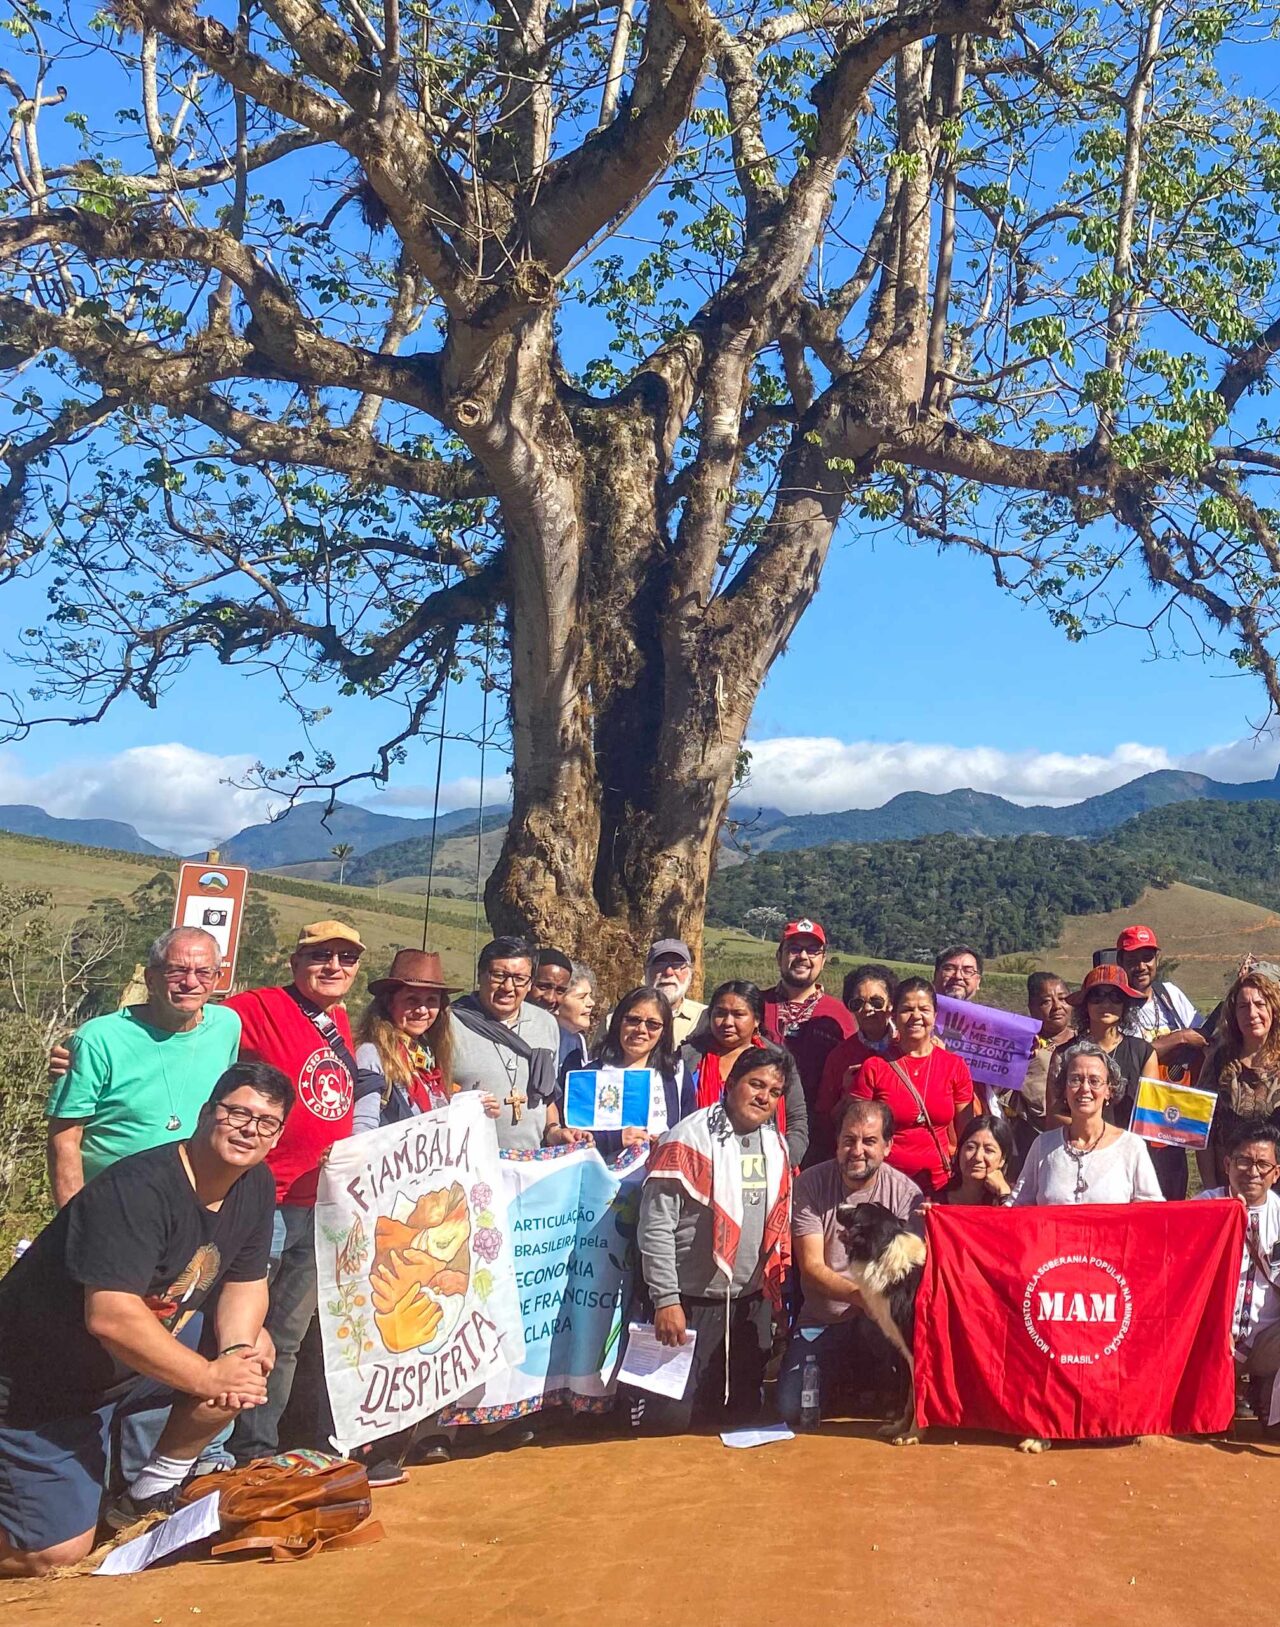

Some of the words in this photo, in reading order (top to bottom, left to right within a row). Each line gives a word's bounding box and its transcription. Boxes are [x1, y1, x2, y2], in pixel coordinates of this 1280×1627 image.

[972, 1021, 986, 1031] LA
[944, 1038, 960, 1049] NO
[961, 1041, 977, 1052] ES
[978, 1046, 1011, 1061] ZONA
[970, 1031, 1015, 1050] MESETA
[306, 1053, 321, 1073] OSO
[964, 1057, 1009, 1075] CRIFICIO
[514, 1207, 595, 1232] ARTICULAÇÃO
[514, 1234, 577, 1257] BRASILEIRA
[580, 1235, 608, 1249] pela
[515, 1259, 594, 1288] ECONOMIA
[1037, 1255, 1088, 1275] SOBERANIA
[1089, 1256, 1126, 1288] POPULAR
[1024, 1274, 1040, 1298] PELA
[1122, 1287, 1132, 1301] NA
[534, 1288, 623, 1312] FRANCISCO
[1037, 1291, 1116, 1322] MAM
[524, 1316, 572, 1343] CLARA
[1023, 1300, 1050, 1353] MOVIMENTO
[1103, 1303, 1133, 1355] MINERAÇÃO
[1060, 1355, 1093, 1364] BRASIL
